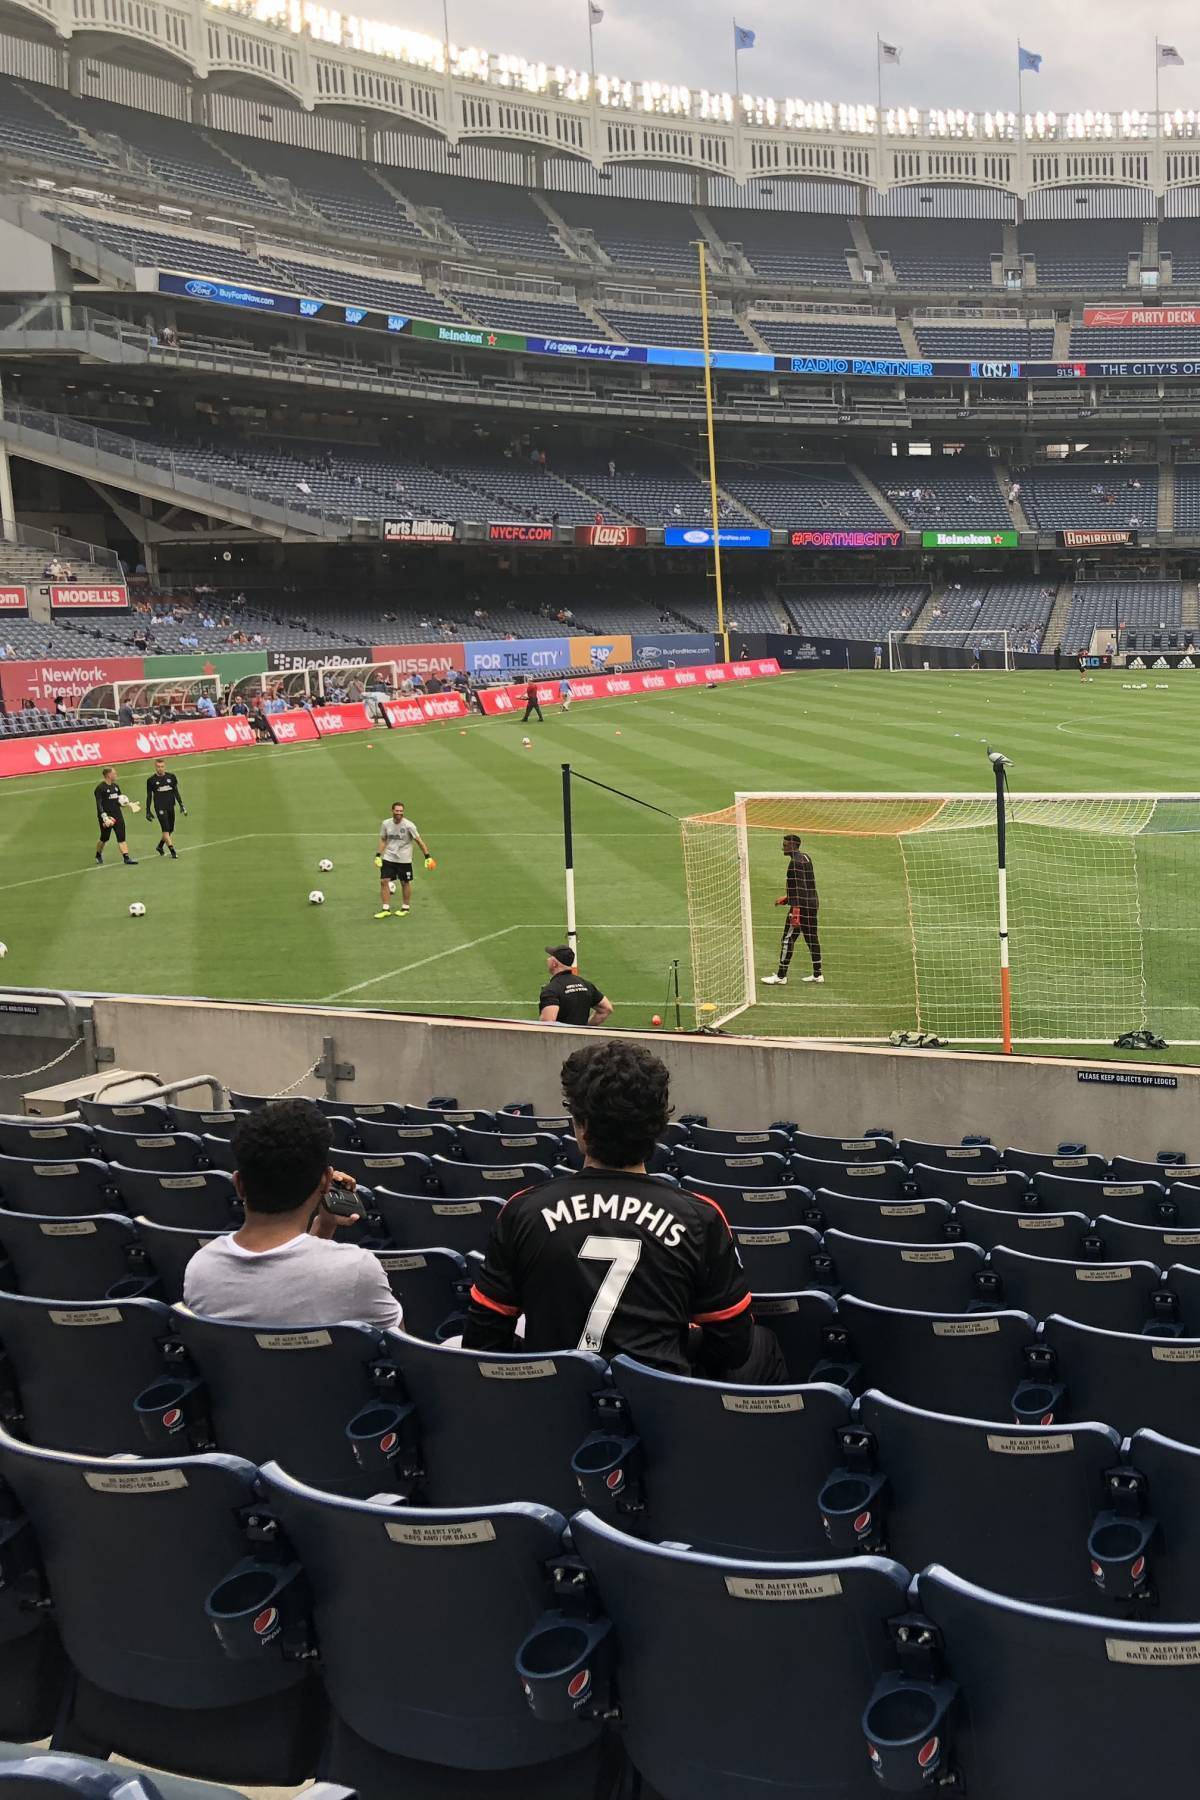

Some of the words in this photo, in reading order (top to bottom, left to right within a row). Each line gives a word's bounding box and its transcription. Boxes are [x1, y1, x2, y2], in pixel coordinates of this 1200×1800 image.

[300, 302, 317, 316] SAP
[345, 311, 361, 323] SAP
[1132, 311, 1164, 323] PARTY
[1167, 311, 1196, 323] DECK
[388, 319, 404, 330] SAP
[439, 328, 482, 344] Heineken
[791, 357, 849, 372] RADIO
[852, 359, 933, 376] PARTNER
[1100, 365, 1128, 375] THE
[1133, 363, 1178, 375] CITY'S
[384, 521, 410, 535] Parts
[411, 520, 455, 537] Authority
[491, 527, 552, 540] NYCFC.COM
[792, 532, 900, 545] #FORTHECITY
[937, 534, 992, 544] Heineken
[57, 590, 120, 603] MODELL'S
[394, 657, 452, 673] NISSAN
[473, 654, 500, 669] FOR
[504, 653, 529, 667] THE
[531, 651, 558, 666] CITY
[42, 666, 107, 682] NewYork-
[431, 698, 461, 715] tinder
[148, 729, 195, 751] tinder
[49, 739, 103, 764] tinder
[1078, 1072, 1100, 1080] PLEASE
[1116, 1075, 1142, 1083] OBJECTS
[1154, 1078, 1176, 1086] LEDGES
[541, 1193, 686, 1247] MEMPHIS
[577, 1235, 642, 1353] 7
[454, 1532, 478, 1540] BALLS
[744, 1588, 764, 1596] BATS
[799, 1587, 824, 1595] BALLS
[261, 1628, 280, 1645] pepsi
[1126, 1651, 1148, 1660] BATS
